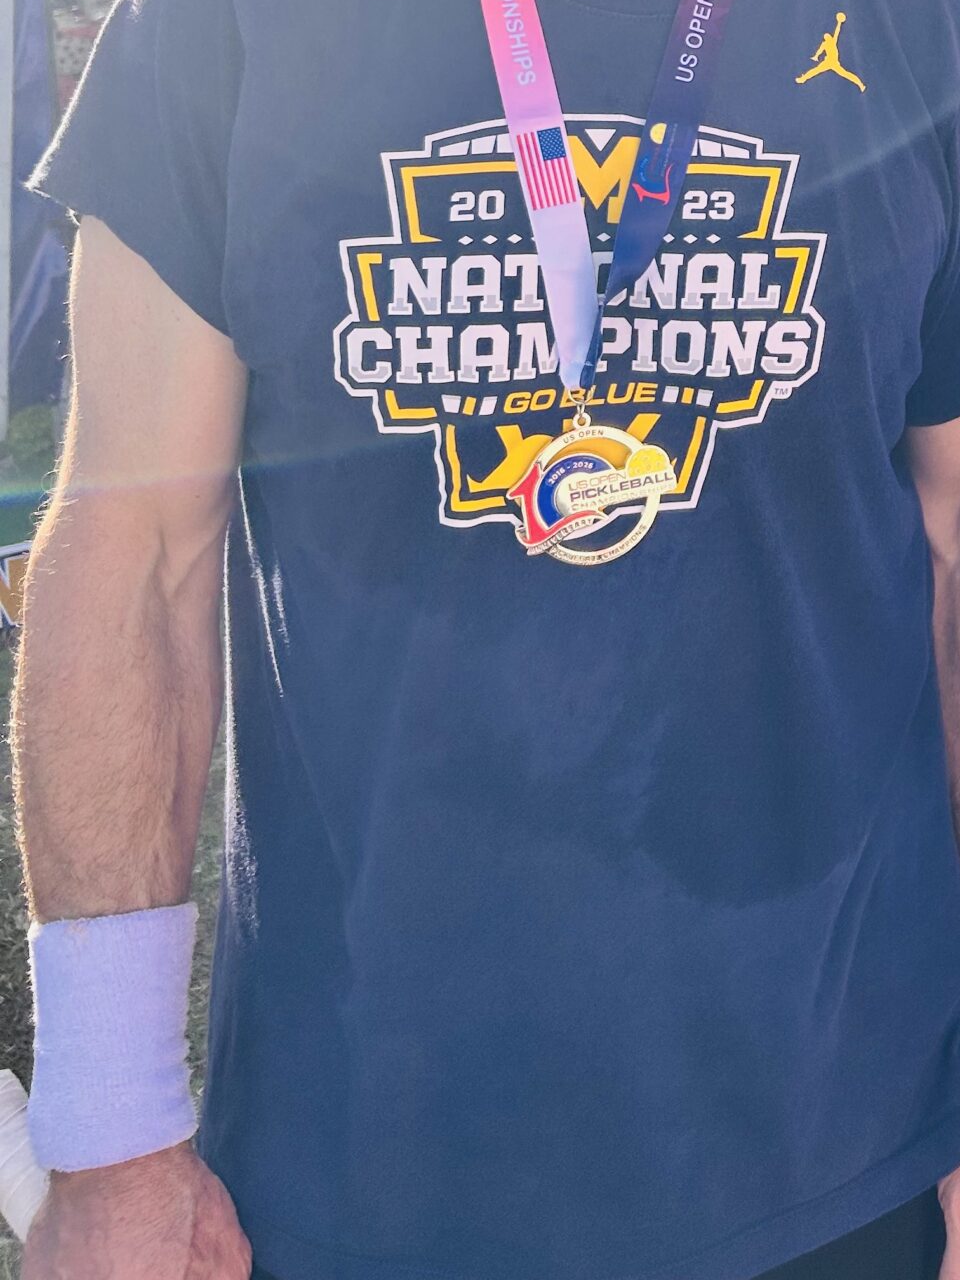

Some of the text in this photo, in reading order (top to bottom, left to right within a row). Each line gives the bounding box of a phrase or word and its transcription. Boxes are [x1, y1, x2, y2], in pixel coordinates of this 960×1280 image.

[675, 53, 698, 83] US
[449, 191, 505, 222] 20
[682, 190, 735, 220] 23
[388, 252, 780, 315] NATNAL
[503, 382, 658, 413] GO BLUE
[563, 429, 604, 444] US OPEN
[548, 467, 565, 484] 2016
[568, 472, 627, 491] US OPEN
[570, 472, 674, 502] PICKLEBALL
